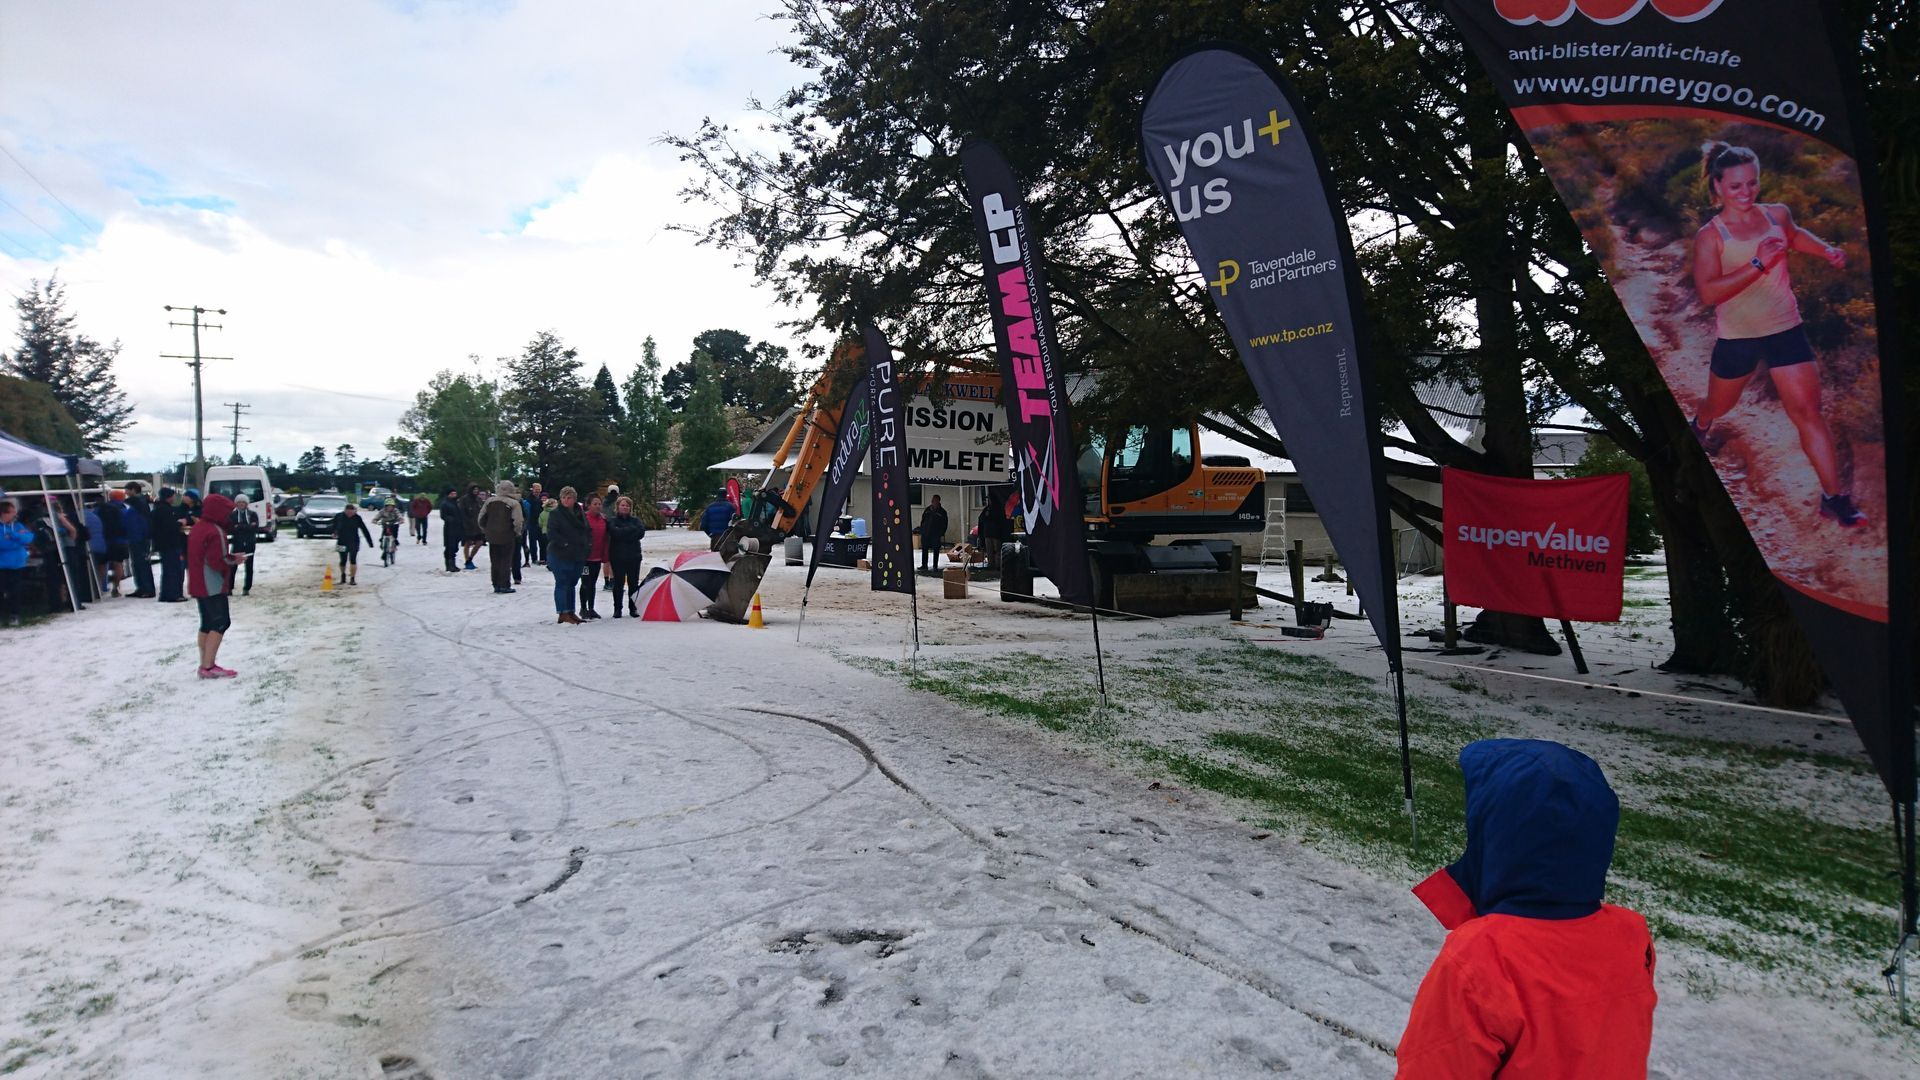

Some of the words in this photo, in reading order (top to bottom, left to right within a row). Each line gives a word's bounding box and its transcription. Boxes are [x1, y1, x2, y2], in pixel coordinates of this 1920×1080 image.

[1508, 41, 1742, 68] anti-blister/anti-chafe
[1513, 73, 1826, 132] www.gurneygoo.com
[1171, 177, 1232, 223] us
[1014, 204, 1026, 239] TEAM
[1021, 242, 1039, 304] COACHING
[1248, 248, 1317, 275] Tavendale
[1250, 272, 1276, 289] and
[1278, 258, 1337, 283] Partners
[1033, 305, 1052, 378] ENDURANCE
[1249, 321, 1334, 348] www.tp.co.nz
[1048, 382, 1059, 417] YOUR
[1336, 348, 1353, 418] Represent.
[876, 361, 898, 467] PURE
[906, 406, 994, 433] ISSION
[907, 447, 1005, 473] MPLETE
[847, 543, 867, 552] PURE
[1528, 552, 1606, 573] Methven
